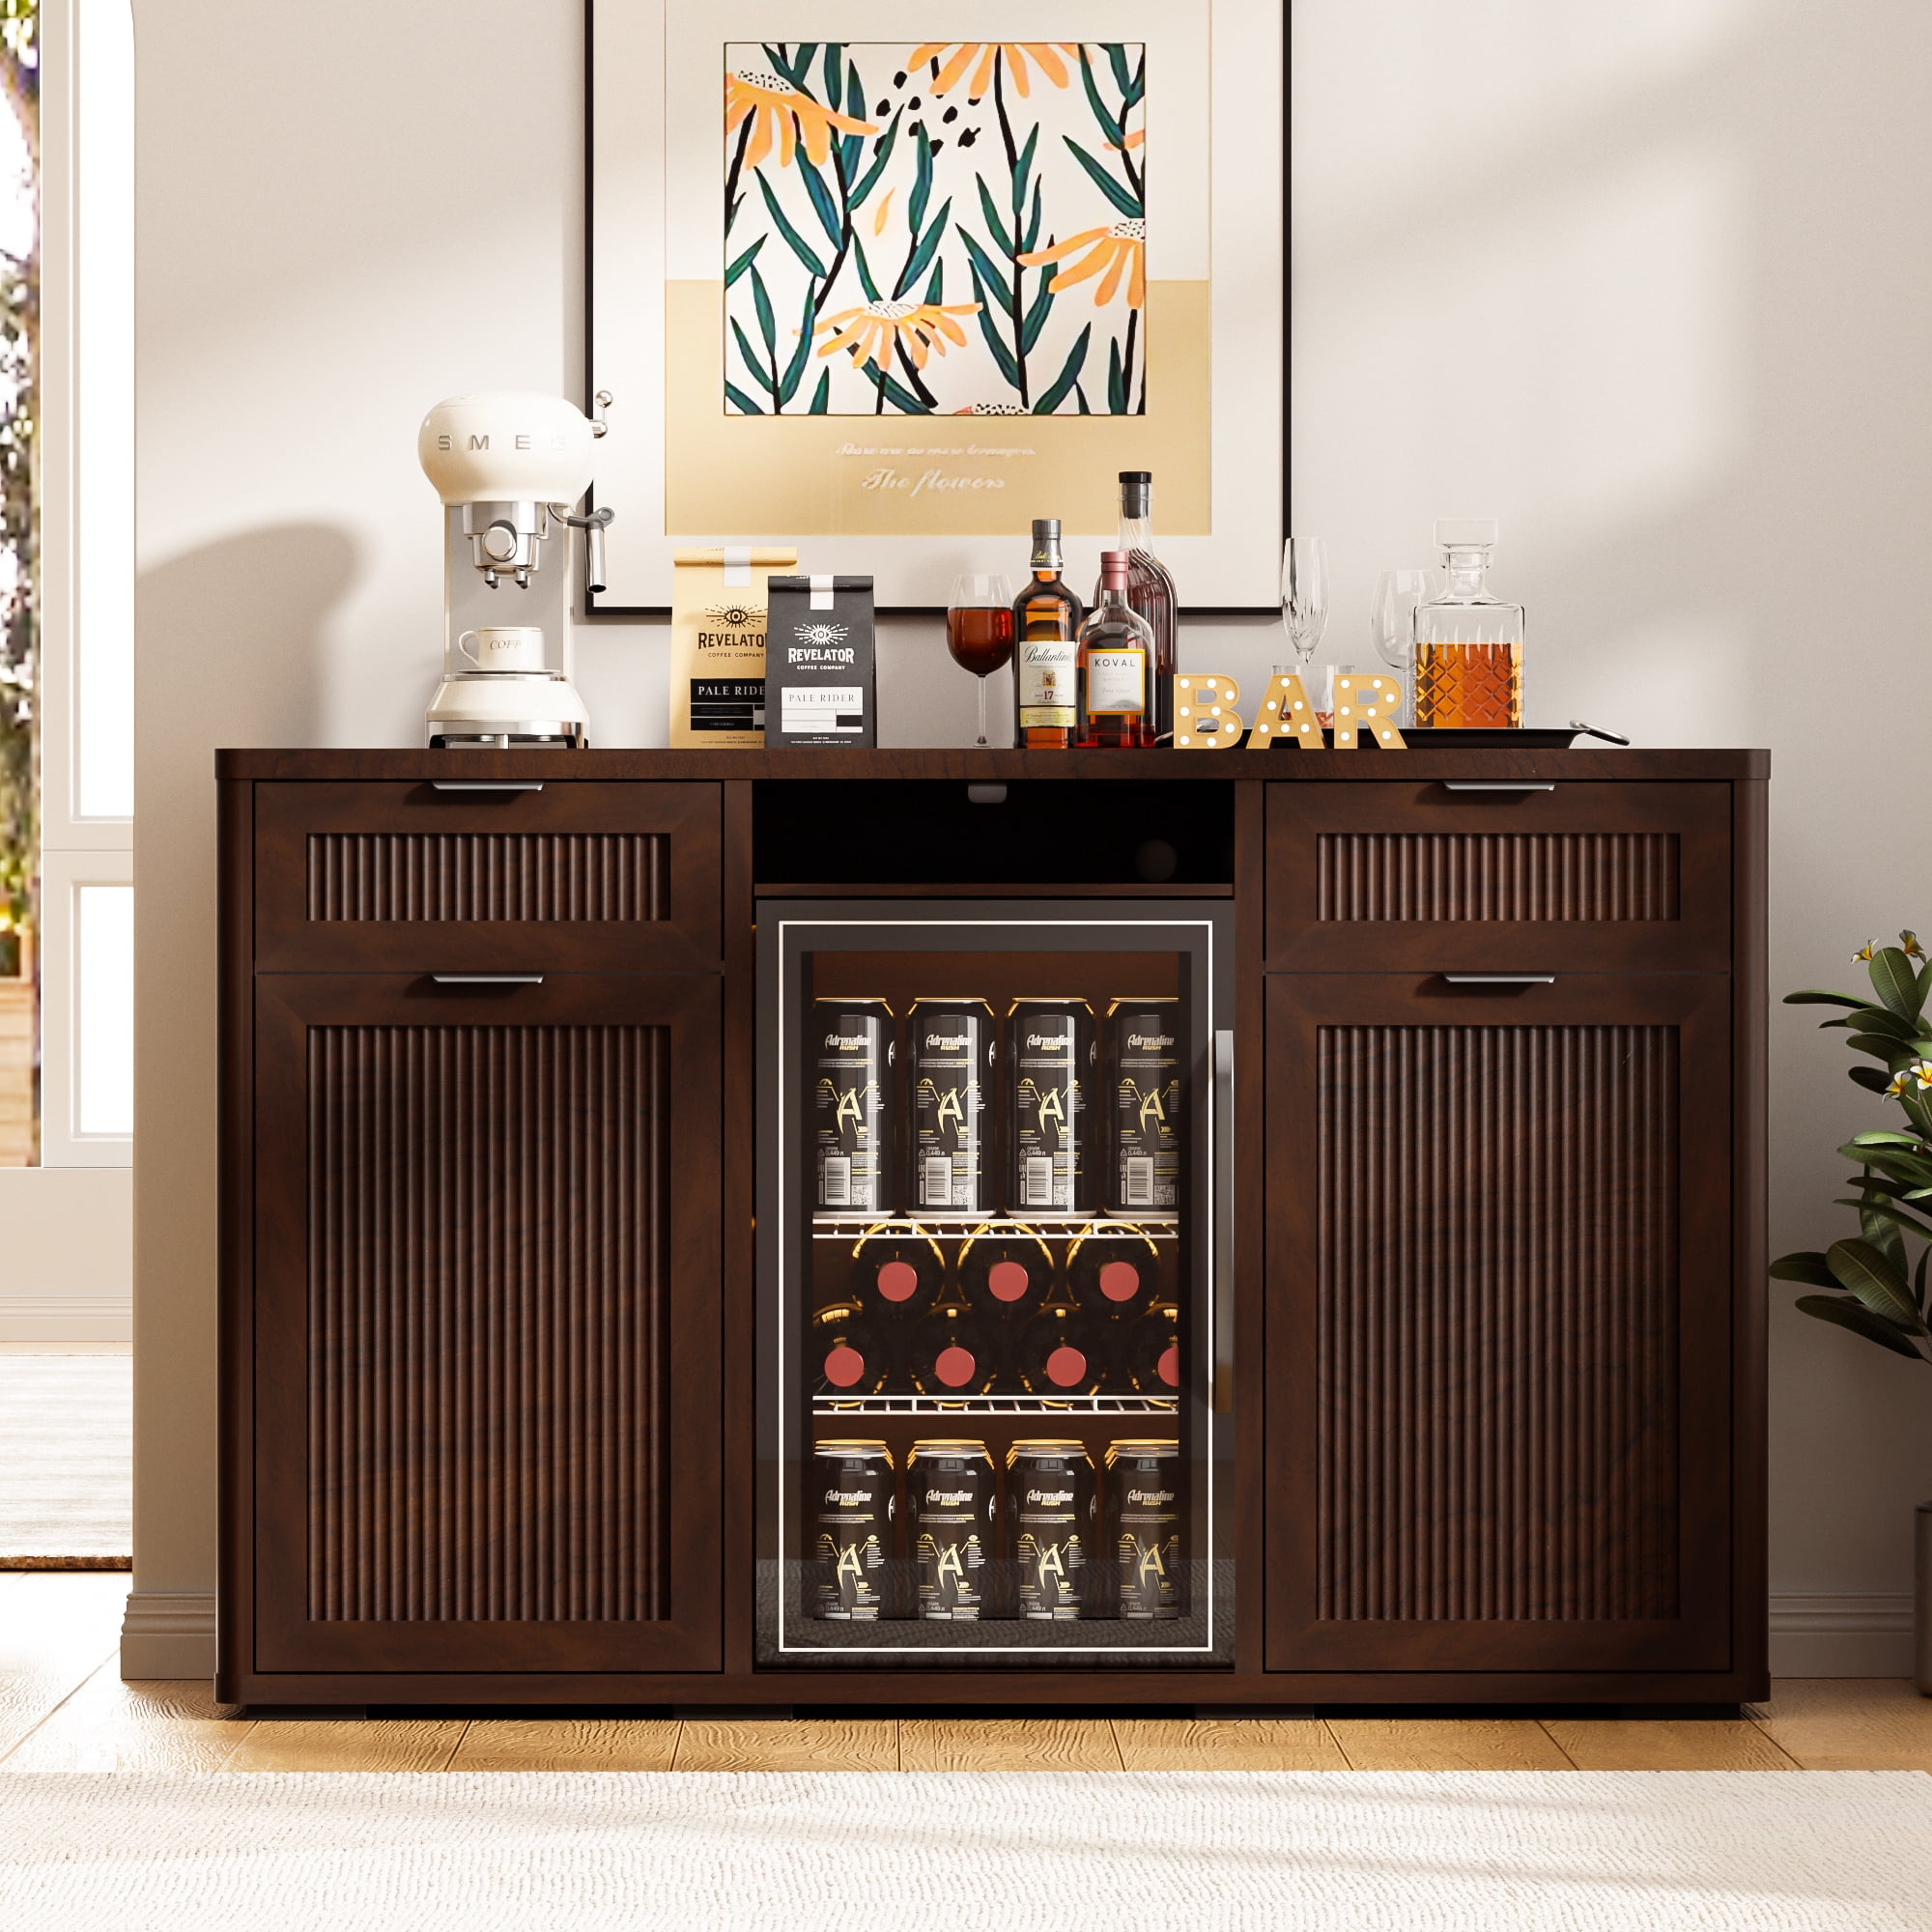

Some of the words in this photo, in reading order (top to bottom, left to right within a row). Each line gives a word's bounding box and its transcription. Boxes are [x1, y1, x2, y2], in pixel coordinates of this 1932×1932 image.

[861, 468, 911, 490] The
[697, 632, 767, 650] REVELATO
[787, 647, 855, 665] REVELATOR
[1094, 658, 1135, 668] KOVAL
[697, 686, 729, 696] PALE
[734, 686, 766, 696] RIDE
[788, 694, 815, 702] PALE
[820, 694, 854, 702] RIDER
[1043, 691, 1054, 700] 17
[1173, 674, 1408, 750] BAR
[825, 1034, 871, 1050] Adrenaline
[926, 1034, 973, 1050] Adrenaline
[1027, 1034, 1073, 1050] Adrenaline
[1127, 1034, 1175, 1050] Adrenaline
[825, 1489, 871, 1505] Adrenaline
[926, 1489, 973, 1505] Adrenaline
[1027, 1489, 1073, 1505] Adrenaline
[1127, 1489, 1175, 1505] Adrenaline
